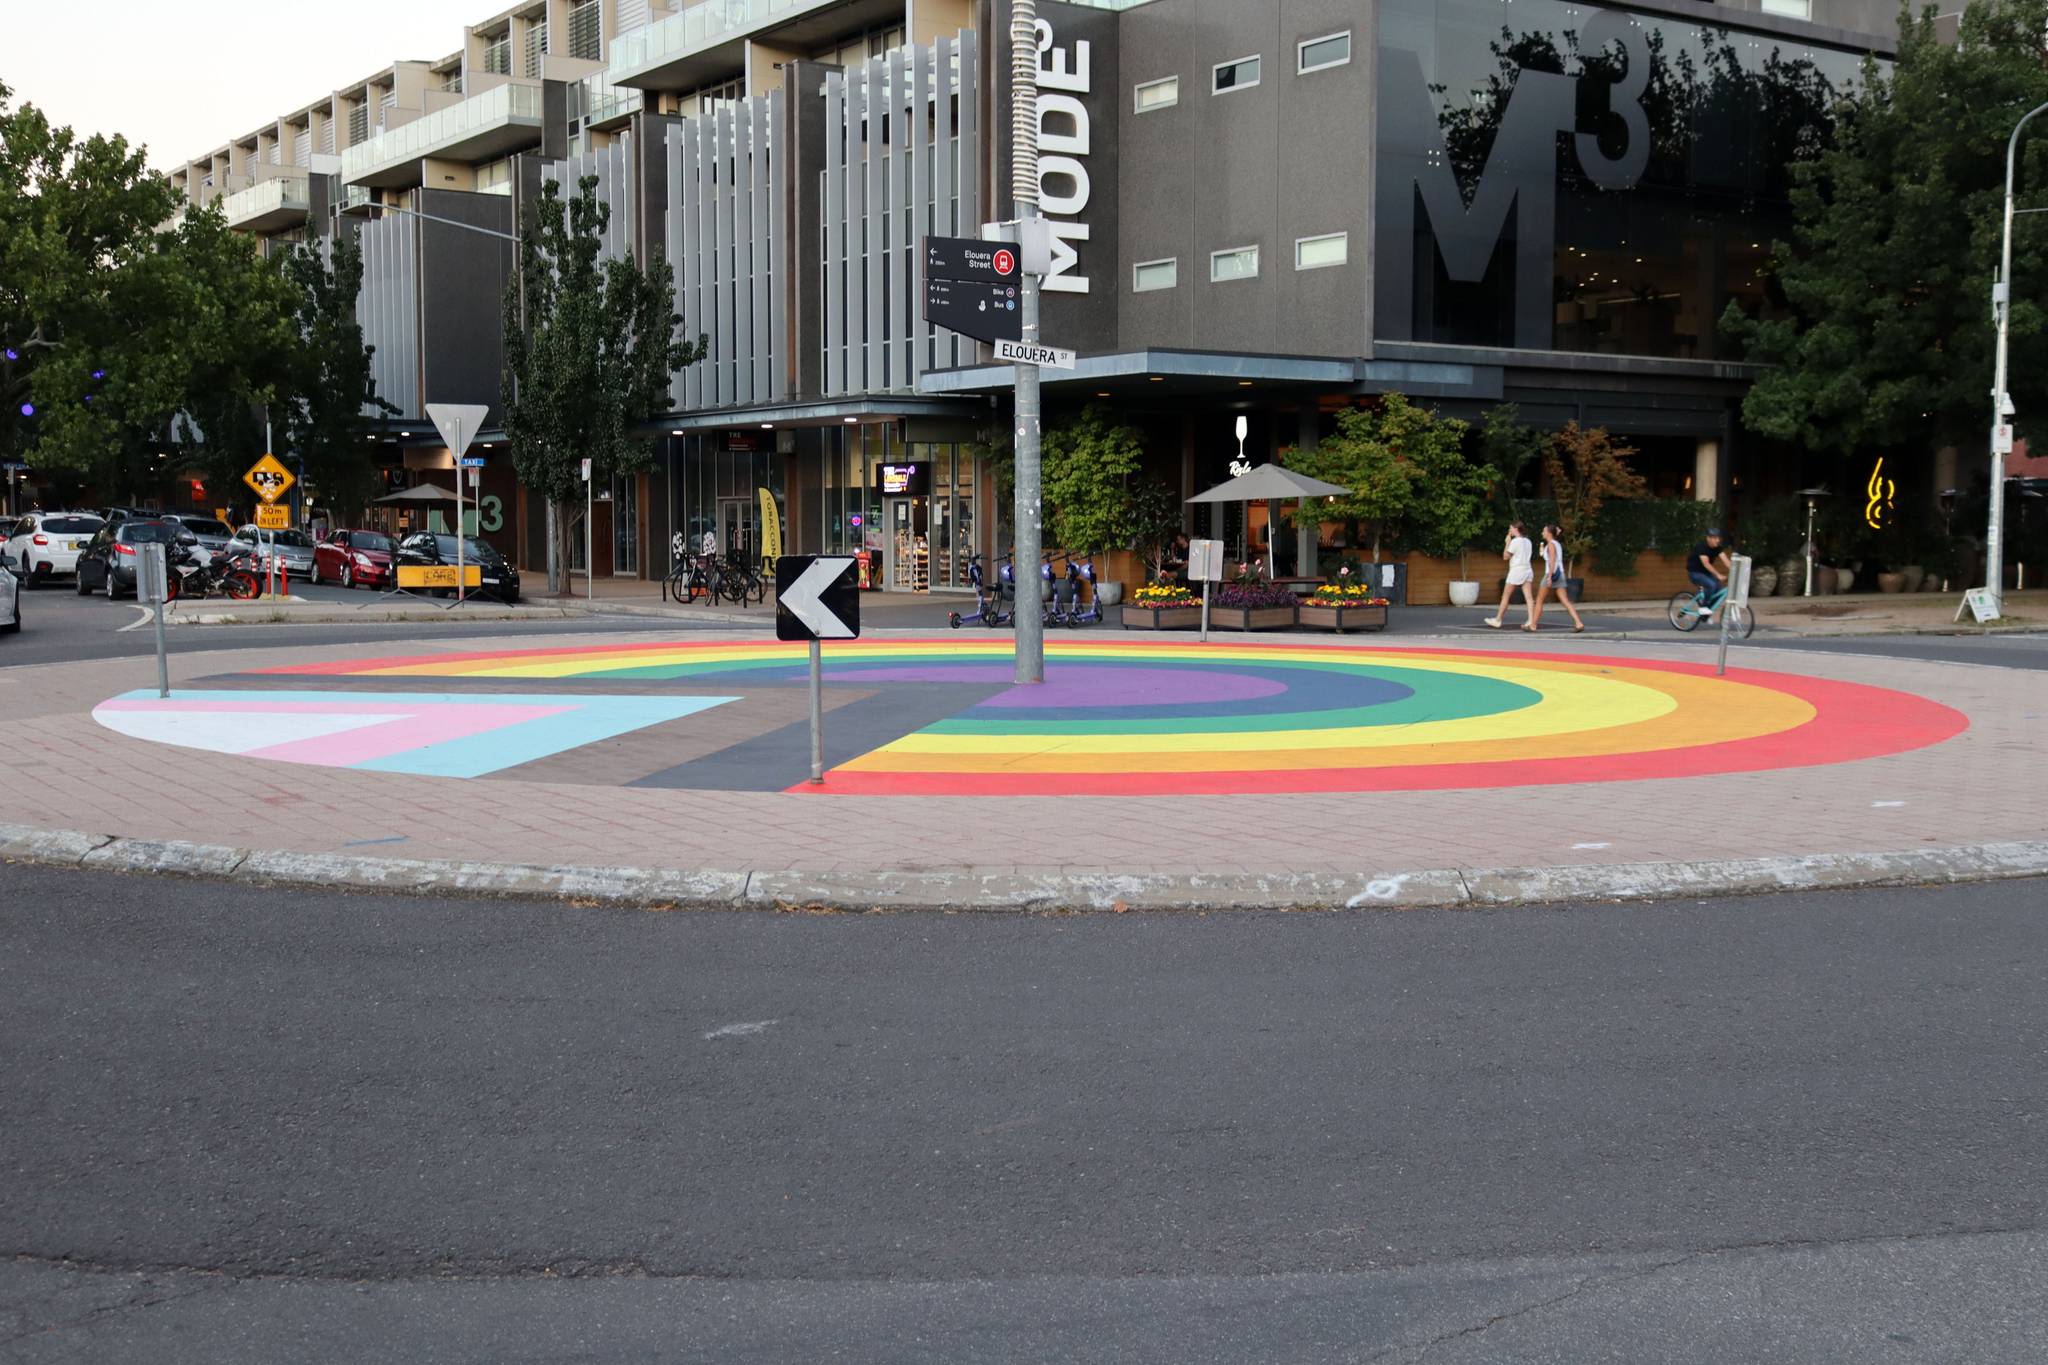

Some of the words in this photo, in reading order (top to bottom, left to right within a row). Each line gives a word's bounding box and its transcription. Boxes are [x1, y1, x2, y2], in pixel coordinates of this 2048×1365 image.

[1372, 10, 1651, 348] M3
[964, 250, 991, 260] Elouera
[969, 260, 991, 269] Street
[994, 301, 1004, 309] Bus
[1002, 343, 1056, 365] ELOUERA
[1060, 353, 1068, 361] ST
[263, 507, 274, 515] 50
[269, 517, 284, 526] LEFT
